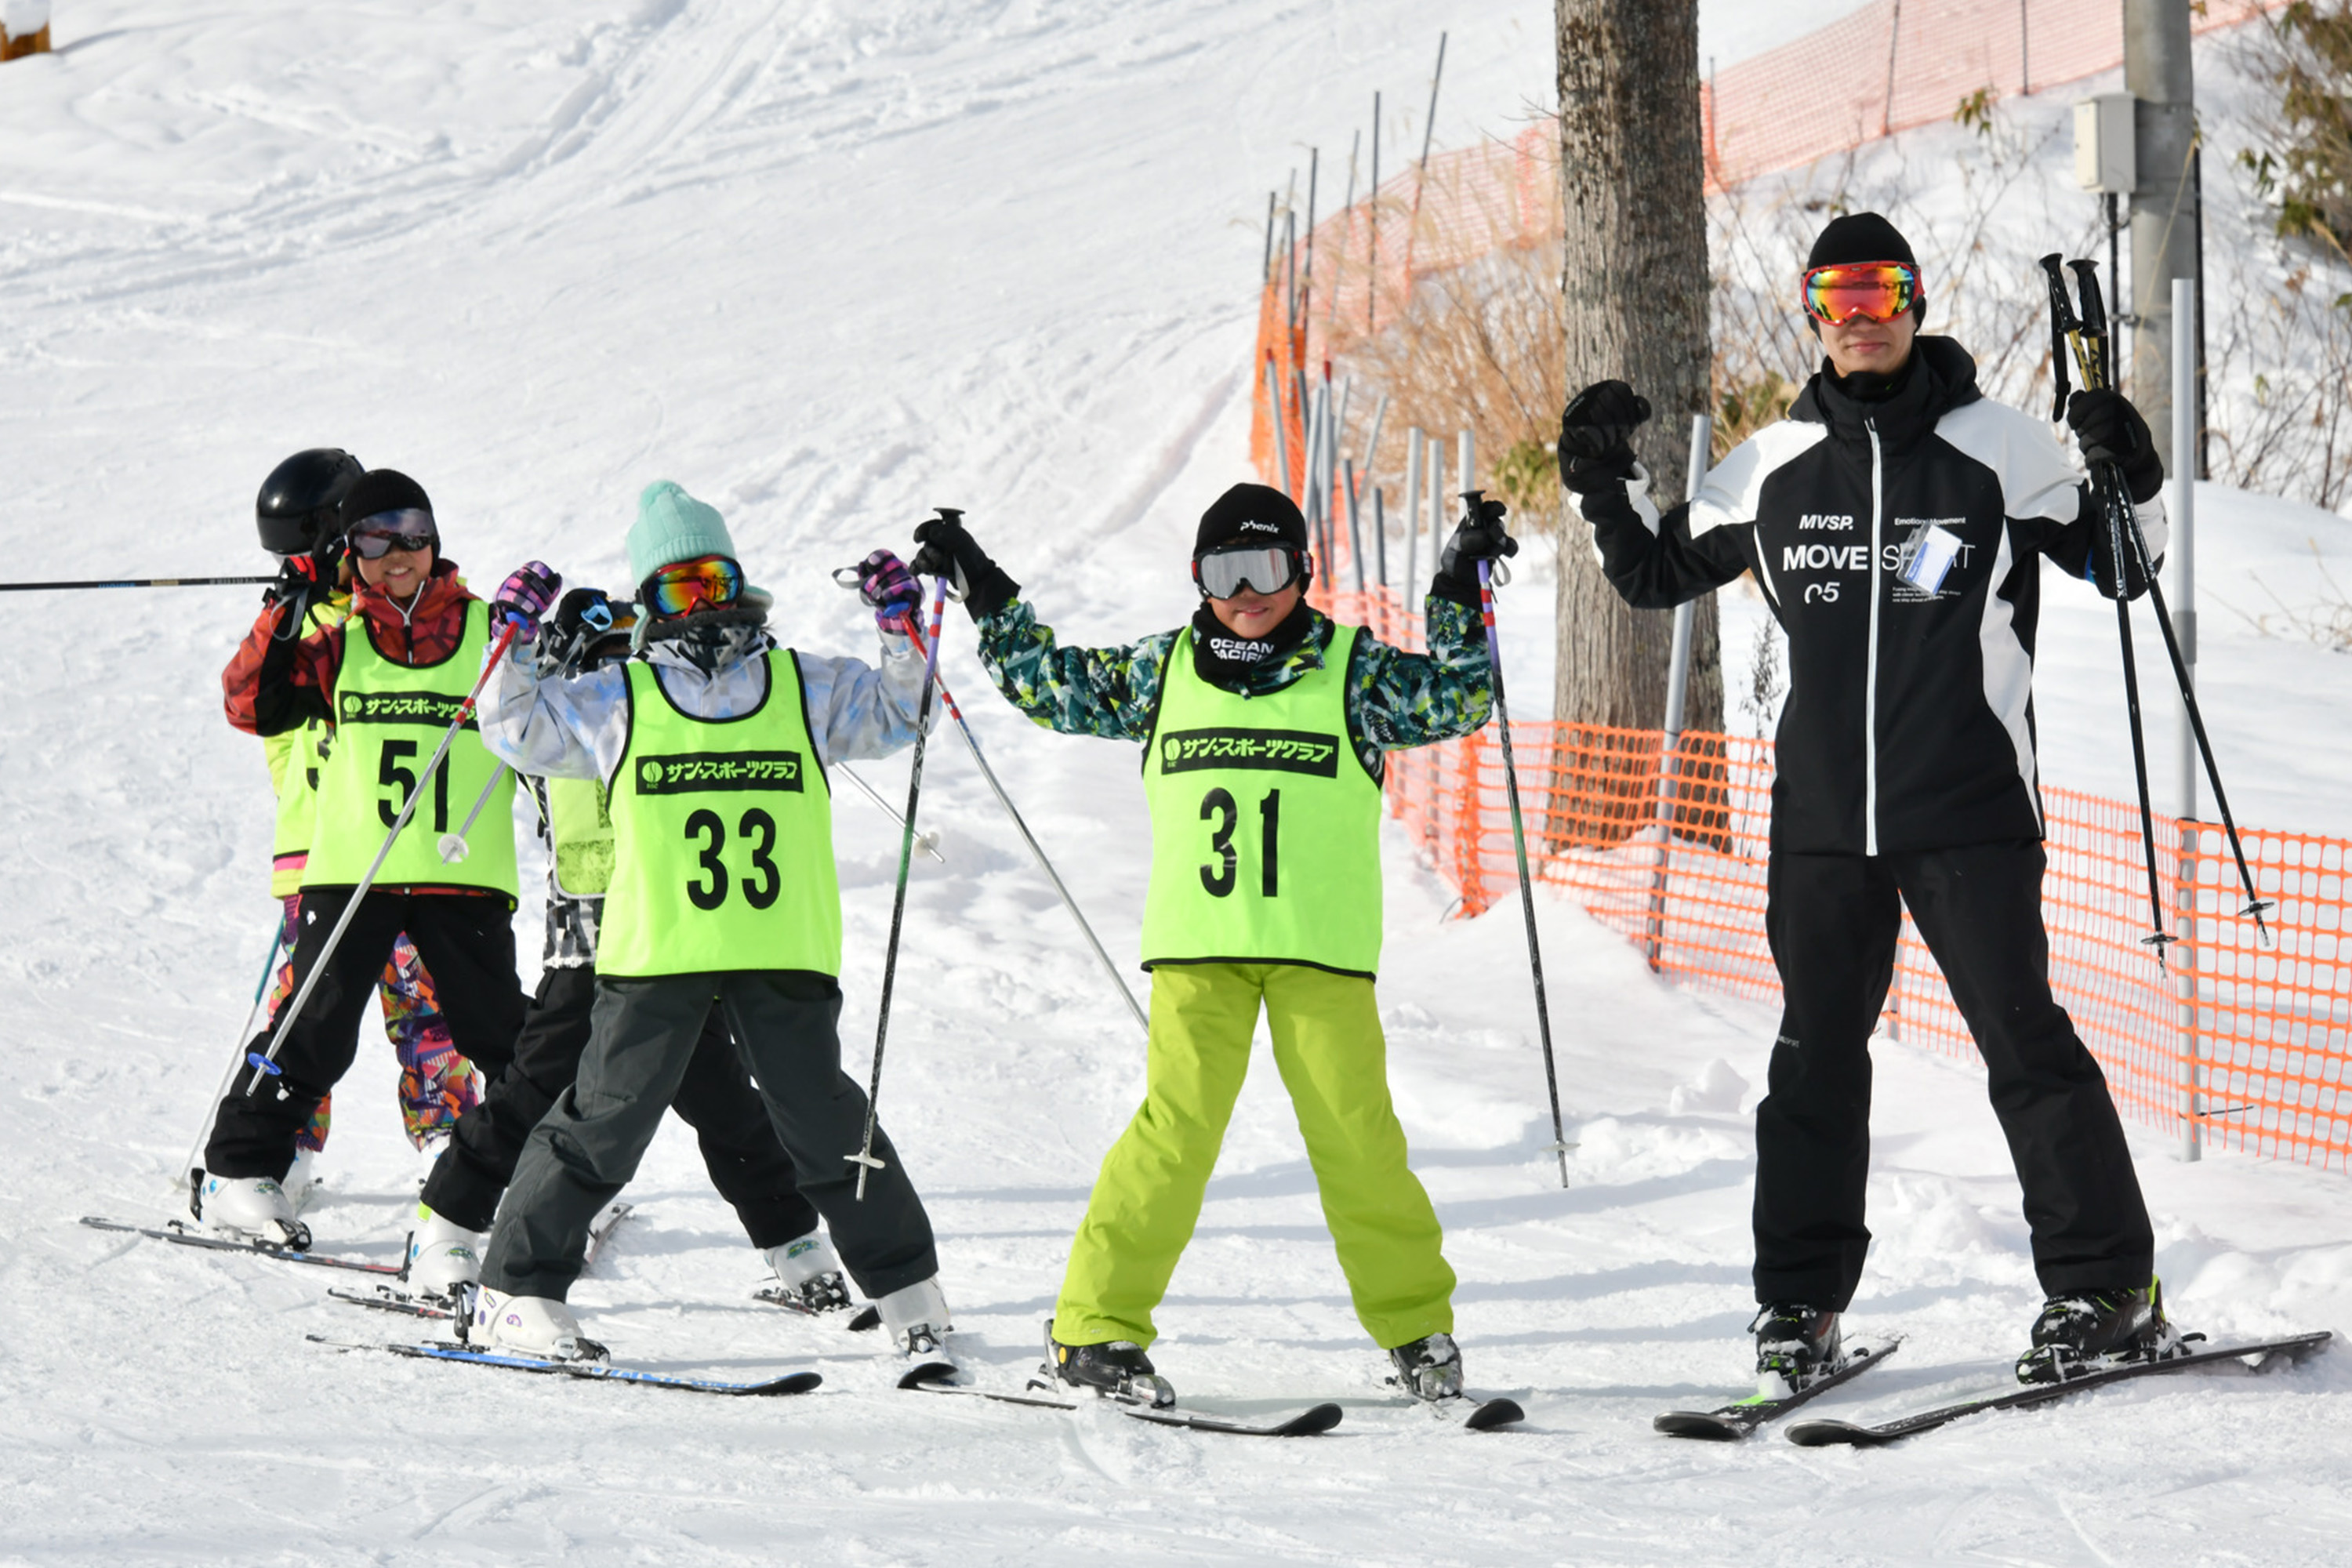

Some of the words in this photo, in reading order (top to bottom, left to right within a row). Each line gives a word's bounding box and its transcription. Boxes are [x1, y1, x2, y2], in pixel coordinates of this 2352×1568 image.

[1240, 519, 1280, 534] phenix
[1799, 514, 1853, 531] MVSP.
[1894, 517, 1929, 526] Emotion
[1783, 544, 1868, 572] MOVE
[1882, 543, 1976, 572] SPT
[1210, 637, 1275, 655] OCEAN
[1213, 648, 1265, 663] ACIFI
[365, 698, 477, 721] サン・スポーツクラ
[378, 739, 450, 833] 51
[1200, 787, 1280, 898] 31
[684, 808, 781, 911] 33
